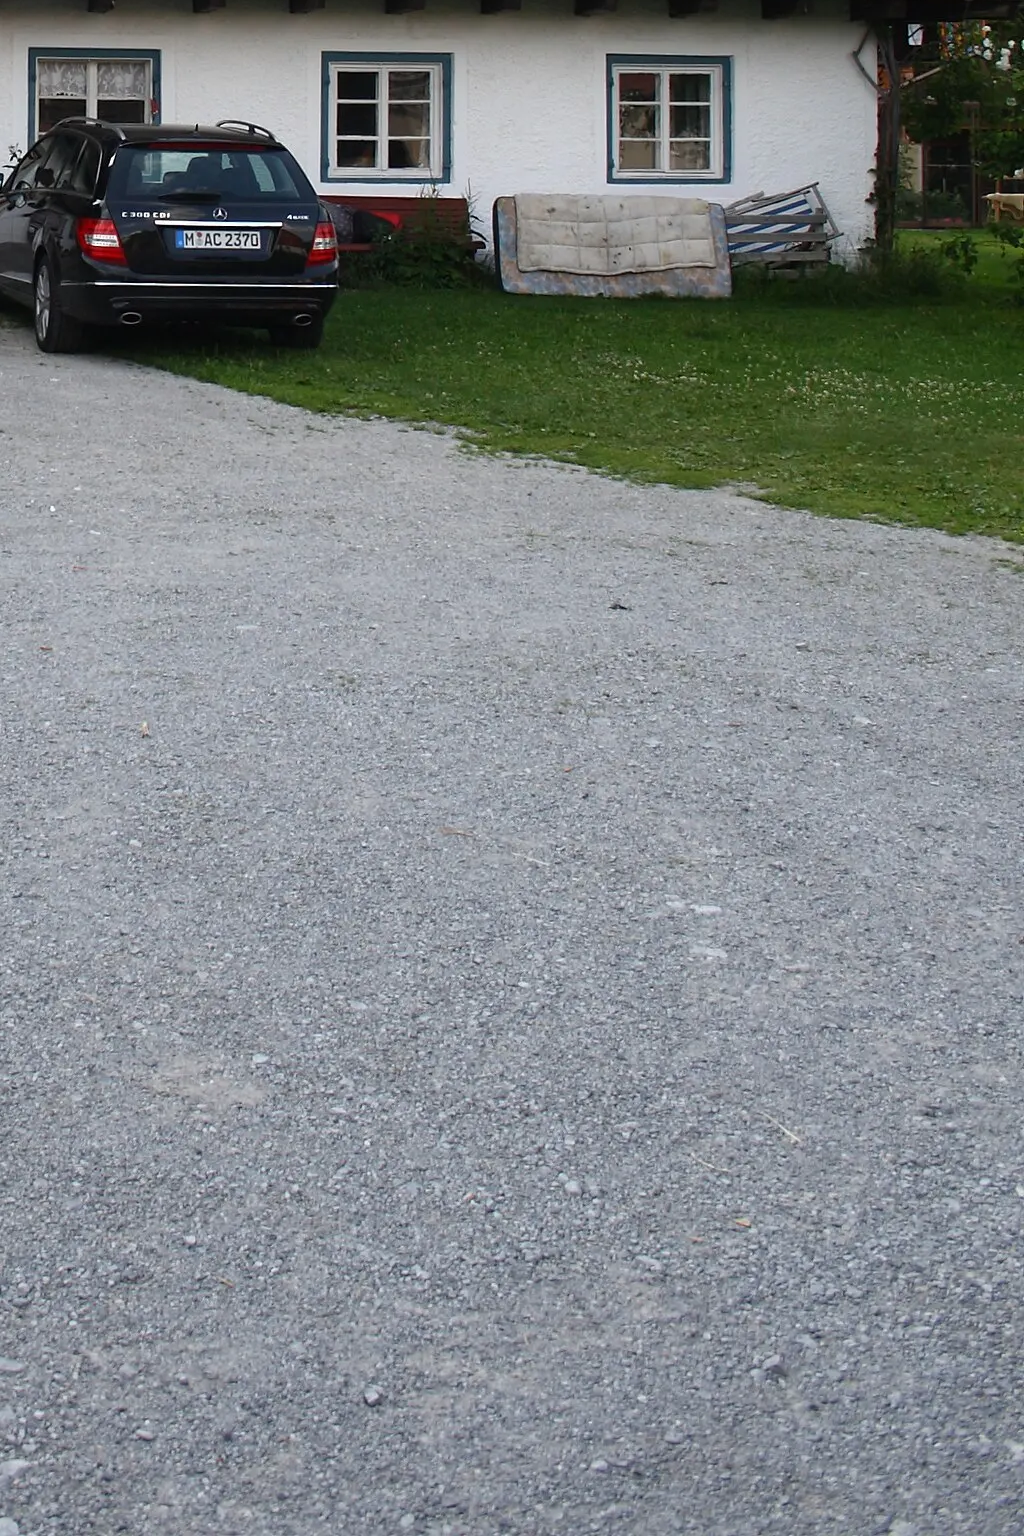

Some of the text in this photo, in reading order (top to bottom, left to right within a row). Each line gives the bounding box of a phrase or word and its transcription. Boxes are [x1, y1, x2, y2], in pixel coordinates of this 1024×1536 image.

[184, 232, 259, 247] M AC 2370
